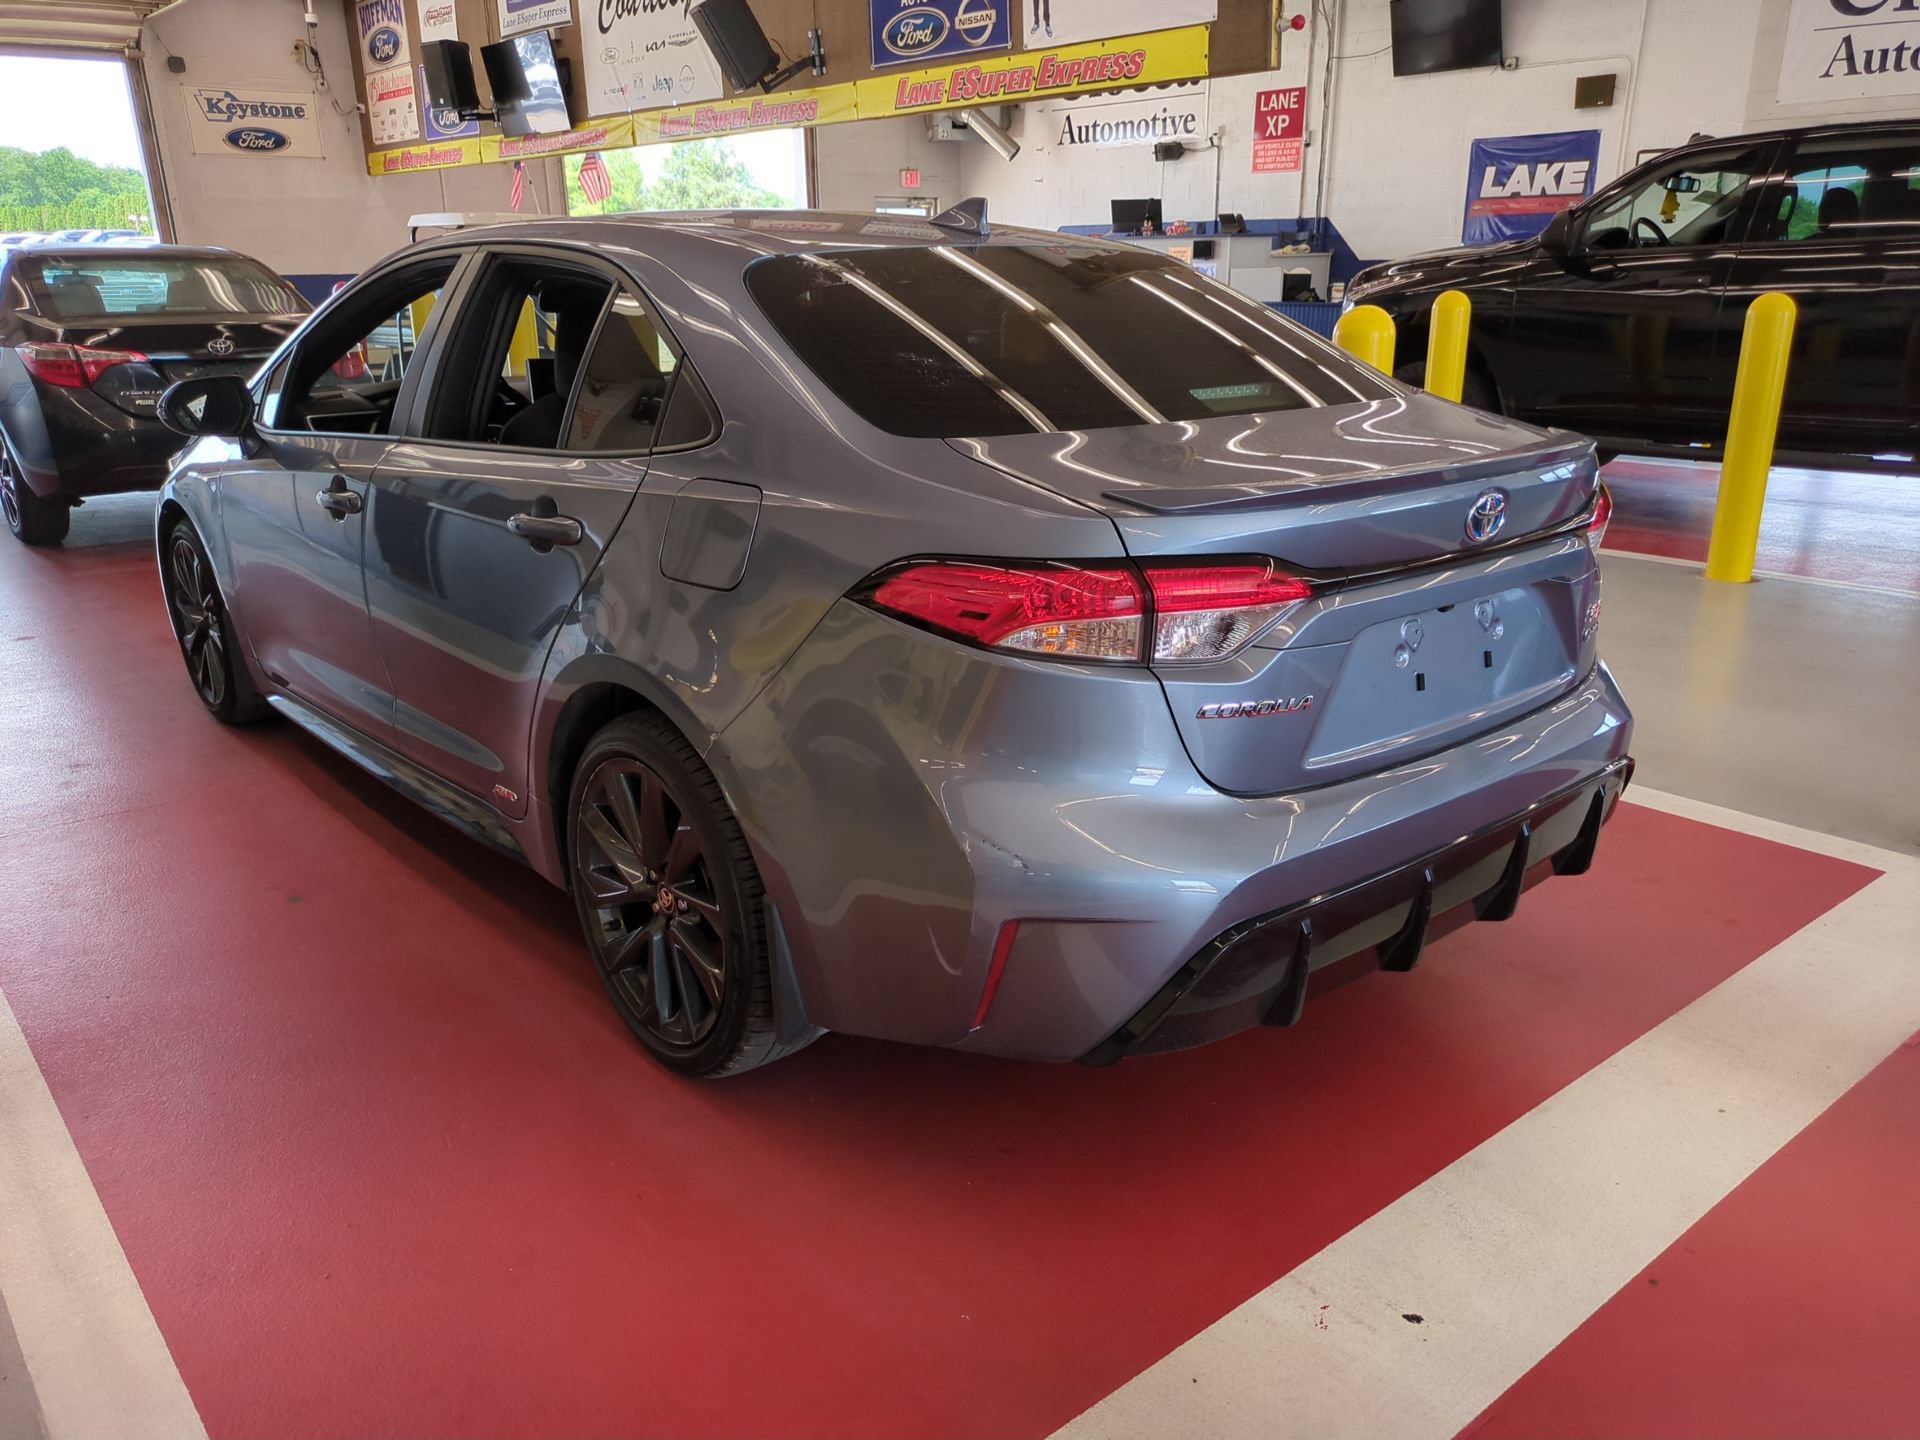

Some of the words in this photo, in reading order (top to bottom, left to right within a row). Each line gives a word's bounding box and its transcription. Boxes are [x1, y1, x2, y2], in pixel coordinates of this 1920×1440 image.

[358, 0, 403, 39] HOFFMAN
[539, 6, 567, 21] Express
[958, 12, 993, 27] NISSAN
[897, 17, 933, 47] Ford
[375, 34, 395, 59] Ford
[653, 75, 674, 93] Jeep
[895, 76, 946, 110] LANE
[1035, 50, 1146, 90] EXPRESS
[203, 97, 305, 120] Keystone
[750, 98, 818, 127] EXPRESS
[1260, 91, 1300, 111] LANE
[1057, 107, 1196, 146] Automotive
[1265, 114, 1290, 137] XP
[238, 131, 276, 149] Ford
[1480, 160, 1590, 198] LAKE
[1195, 695, 1314, 719] COROLLA
